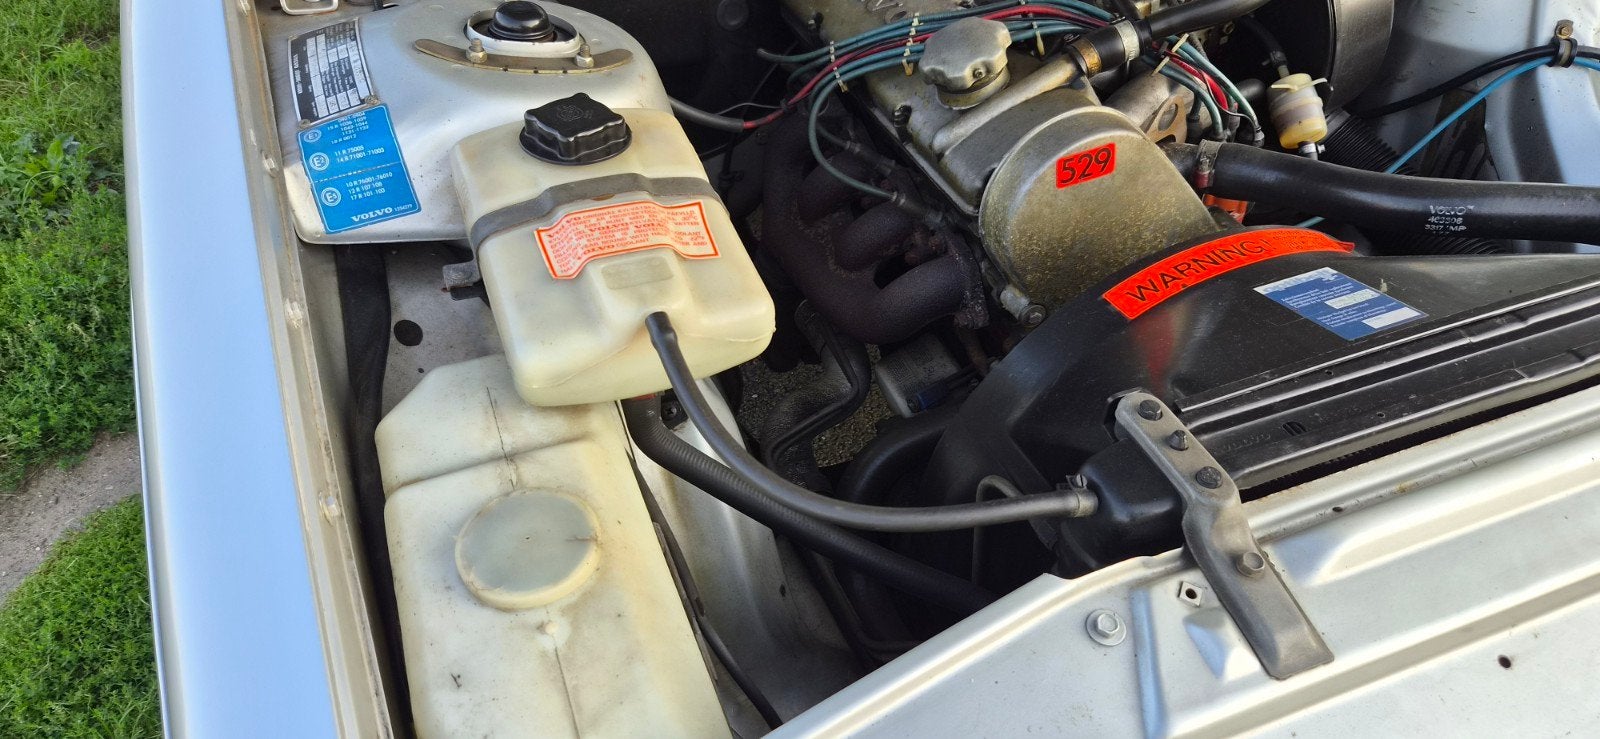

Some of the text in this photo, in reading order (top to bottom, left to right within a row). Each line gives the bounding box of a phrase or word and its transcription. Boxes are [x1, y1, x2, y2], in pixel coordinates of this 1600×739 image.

[1060, 147, 1112, 184] 529
[350, 206, 393, 222] VOLVO
[1429, 205, 1467, 215] VOLVO
[1124, 238, 1275, 303] WARNING!
